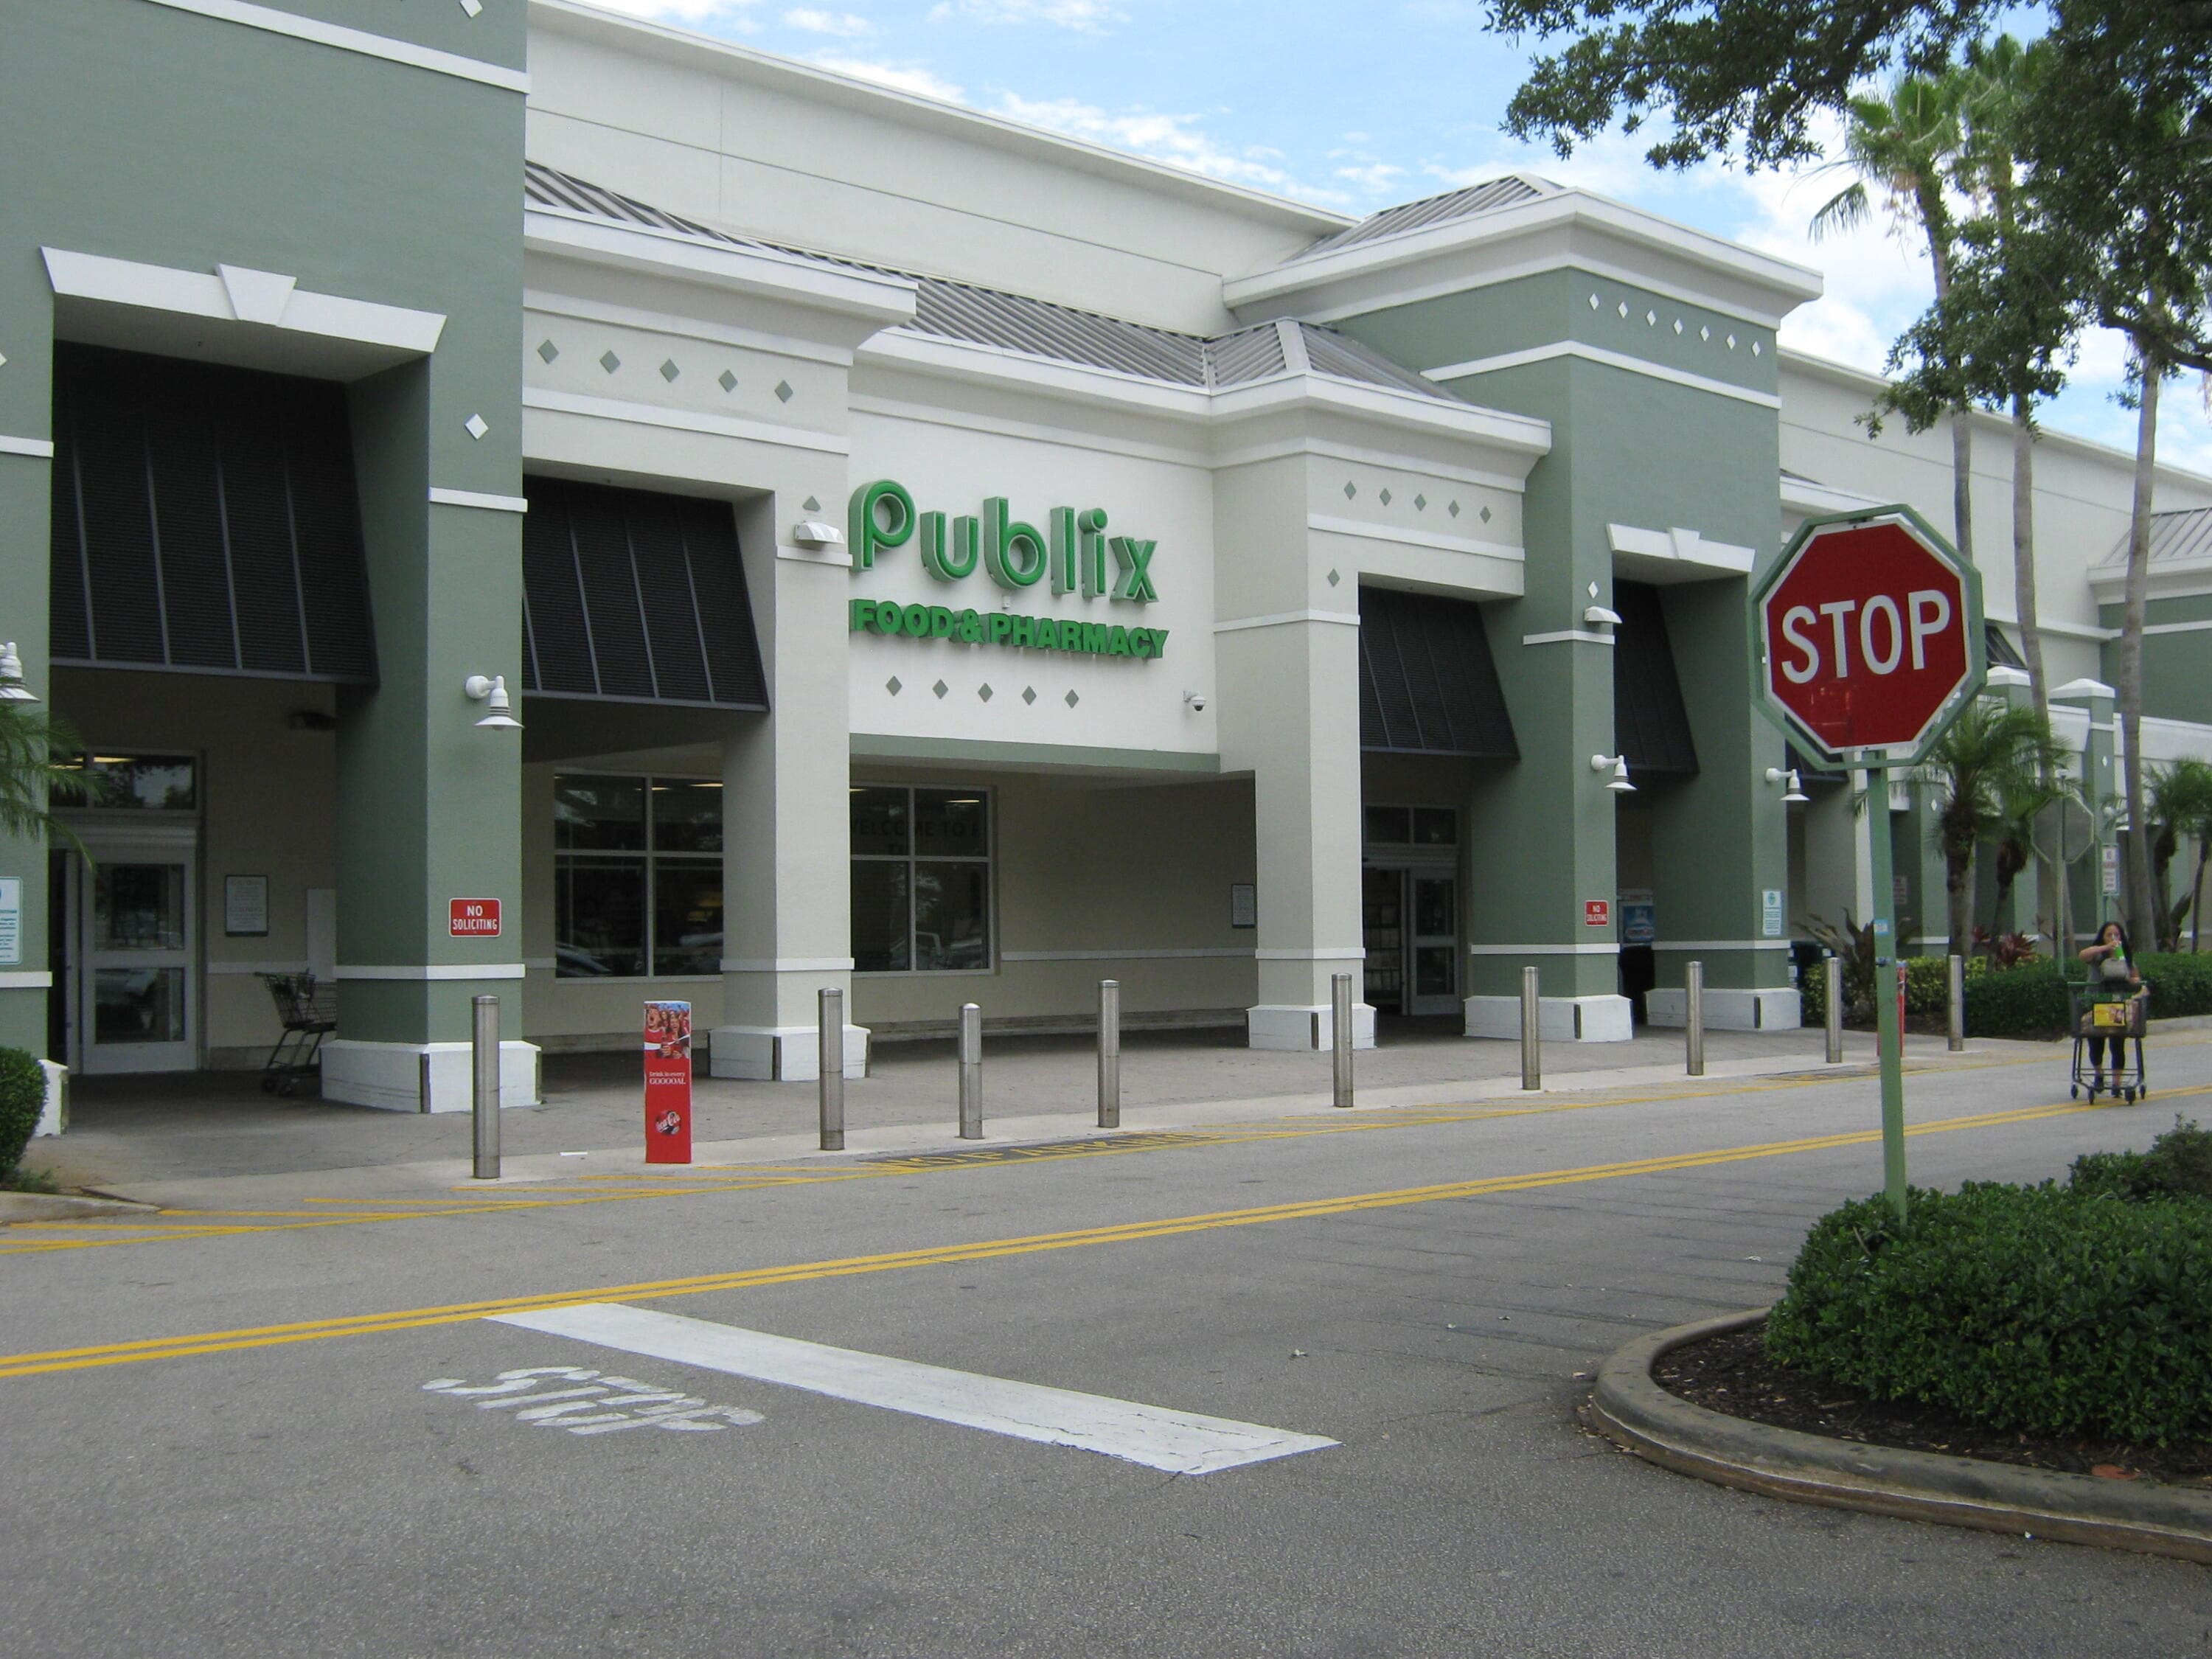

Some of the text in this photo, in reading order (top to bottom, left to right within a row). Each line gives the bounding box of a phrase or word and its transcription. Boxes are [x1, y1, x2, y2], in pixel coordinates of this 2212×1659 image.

[849, 479, 1158, 602] Publix
[988, 612, 1169, 658] PHARMACY
[1781, 590, 1950, 684] STOP
[452, 918, 498, 931] SOLICITING
[467, 905, 483, 917] NO
